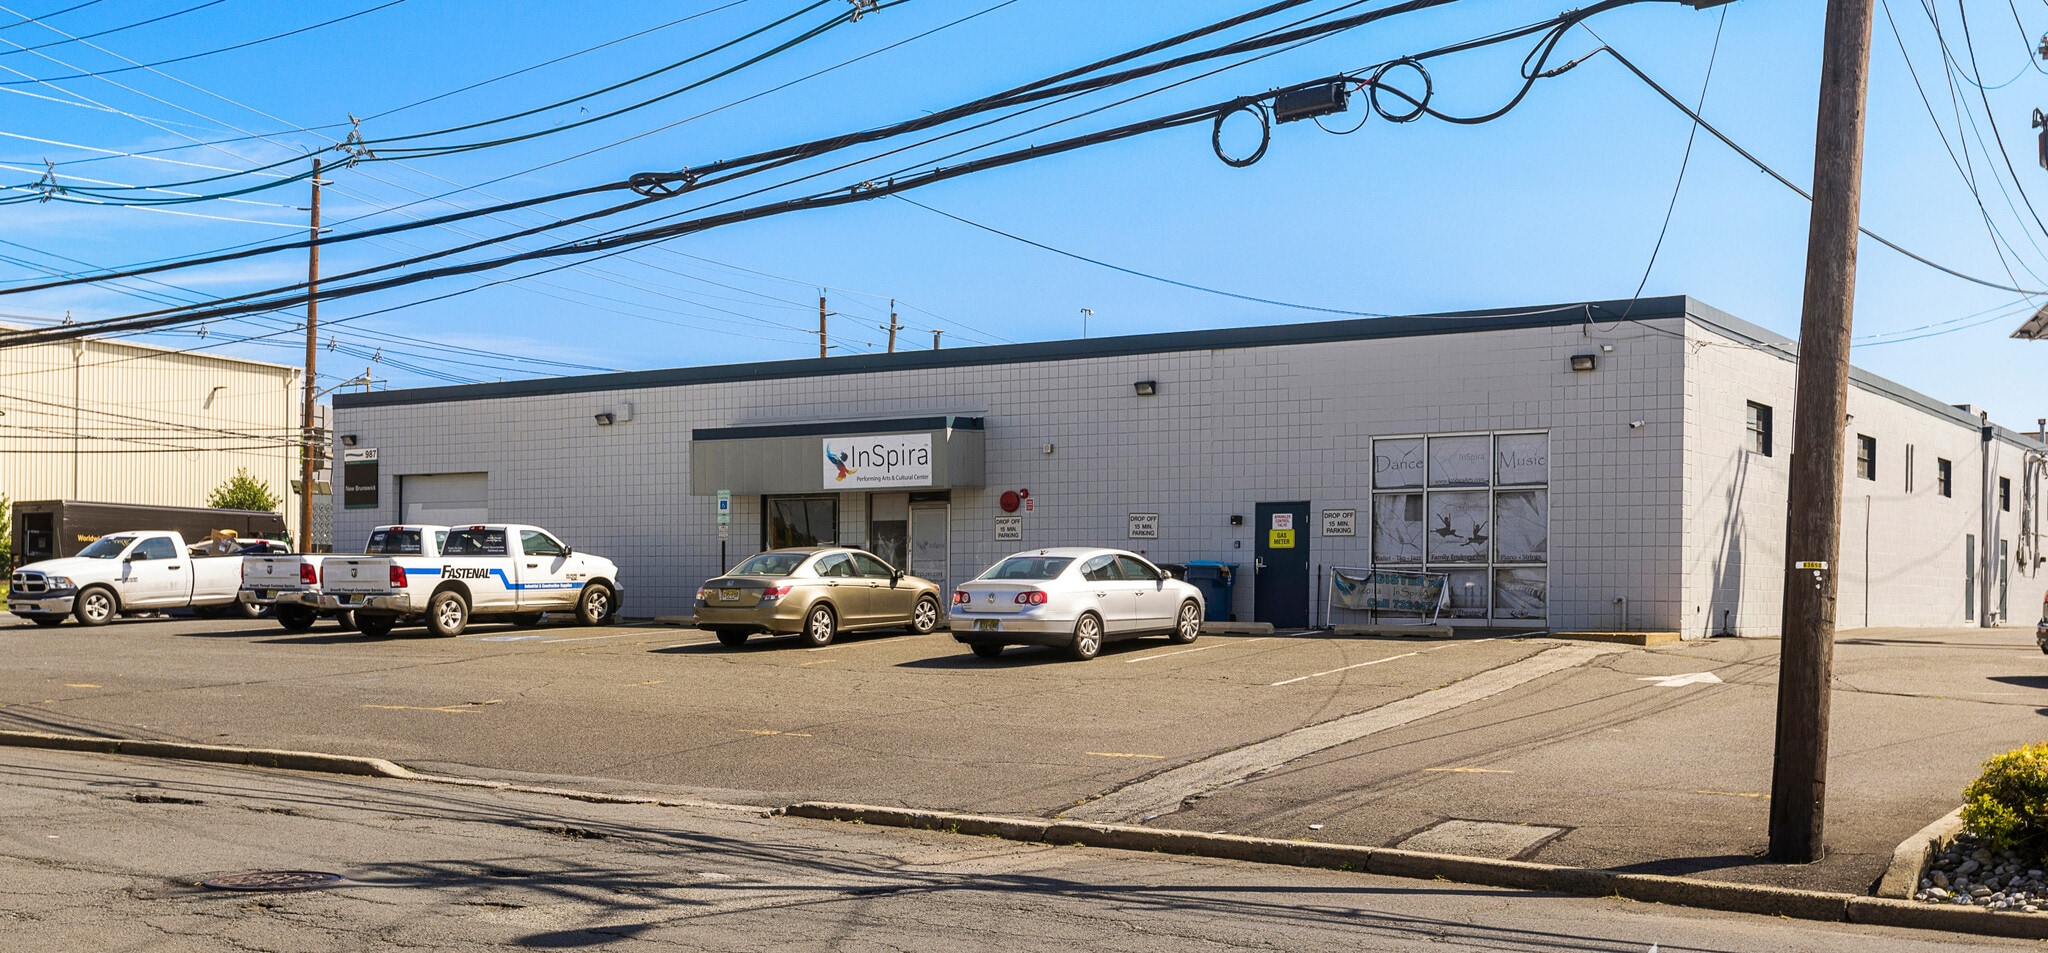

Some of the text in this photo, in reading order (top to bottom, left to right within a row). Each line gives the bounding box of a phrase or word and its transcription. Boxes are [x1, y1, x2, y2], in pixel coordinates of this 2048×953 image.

[365, 450, 376, 458] 987
[851, 443, 928, 473] InSpira
[1459, 453, 1485, 462] InSpira
[1500, 451, 1546, 469] Music
[1376, 455, 1424, 473] Dance
[441, 565, 490, 579] FASTENAL
[1361, 573, 1425, 588] EGISTER
